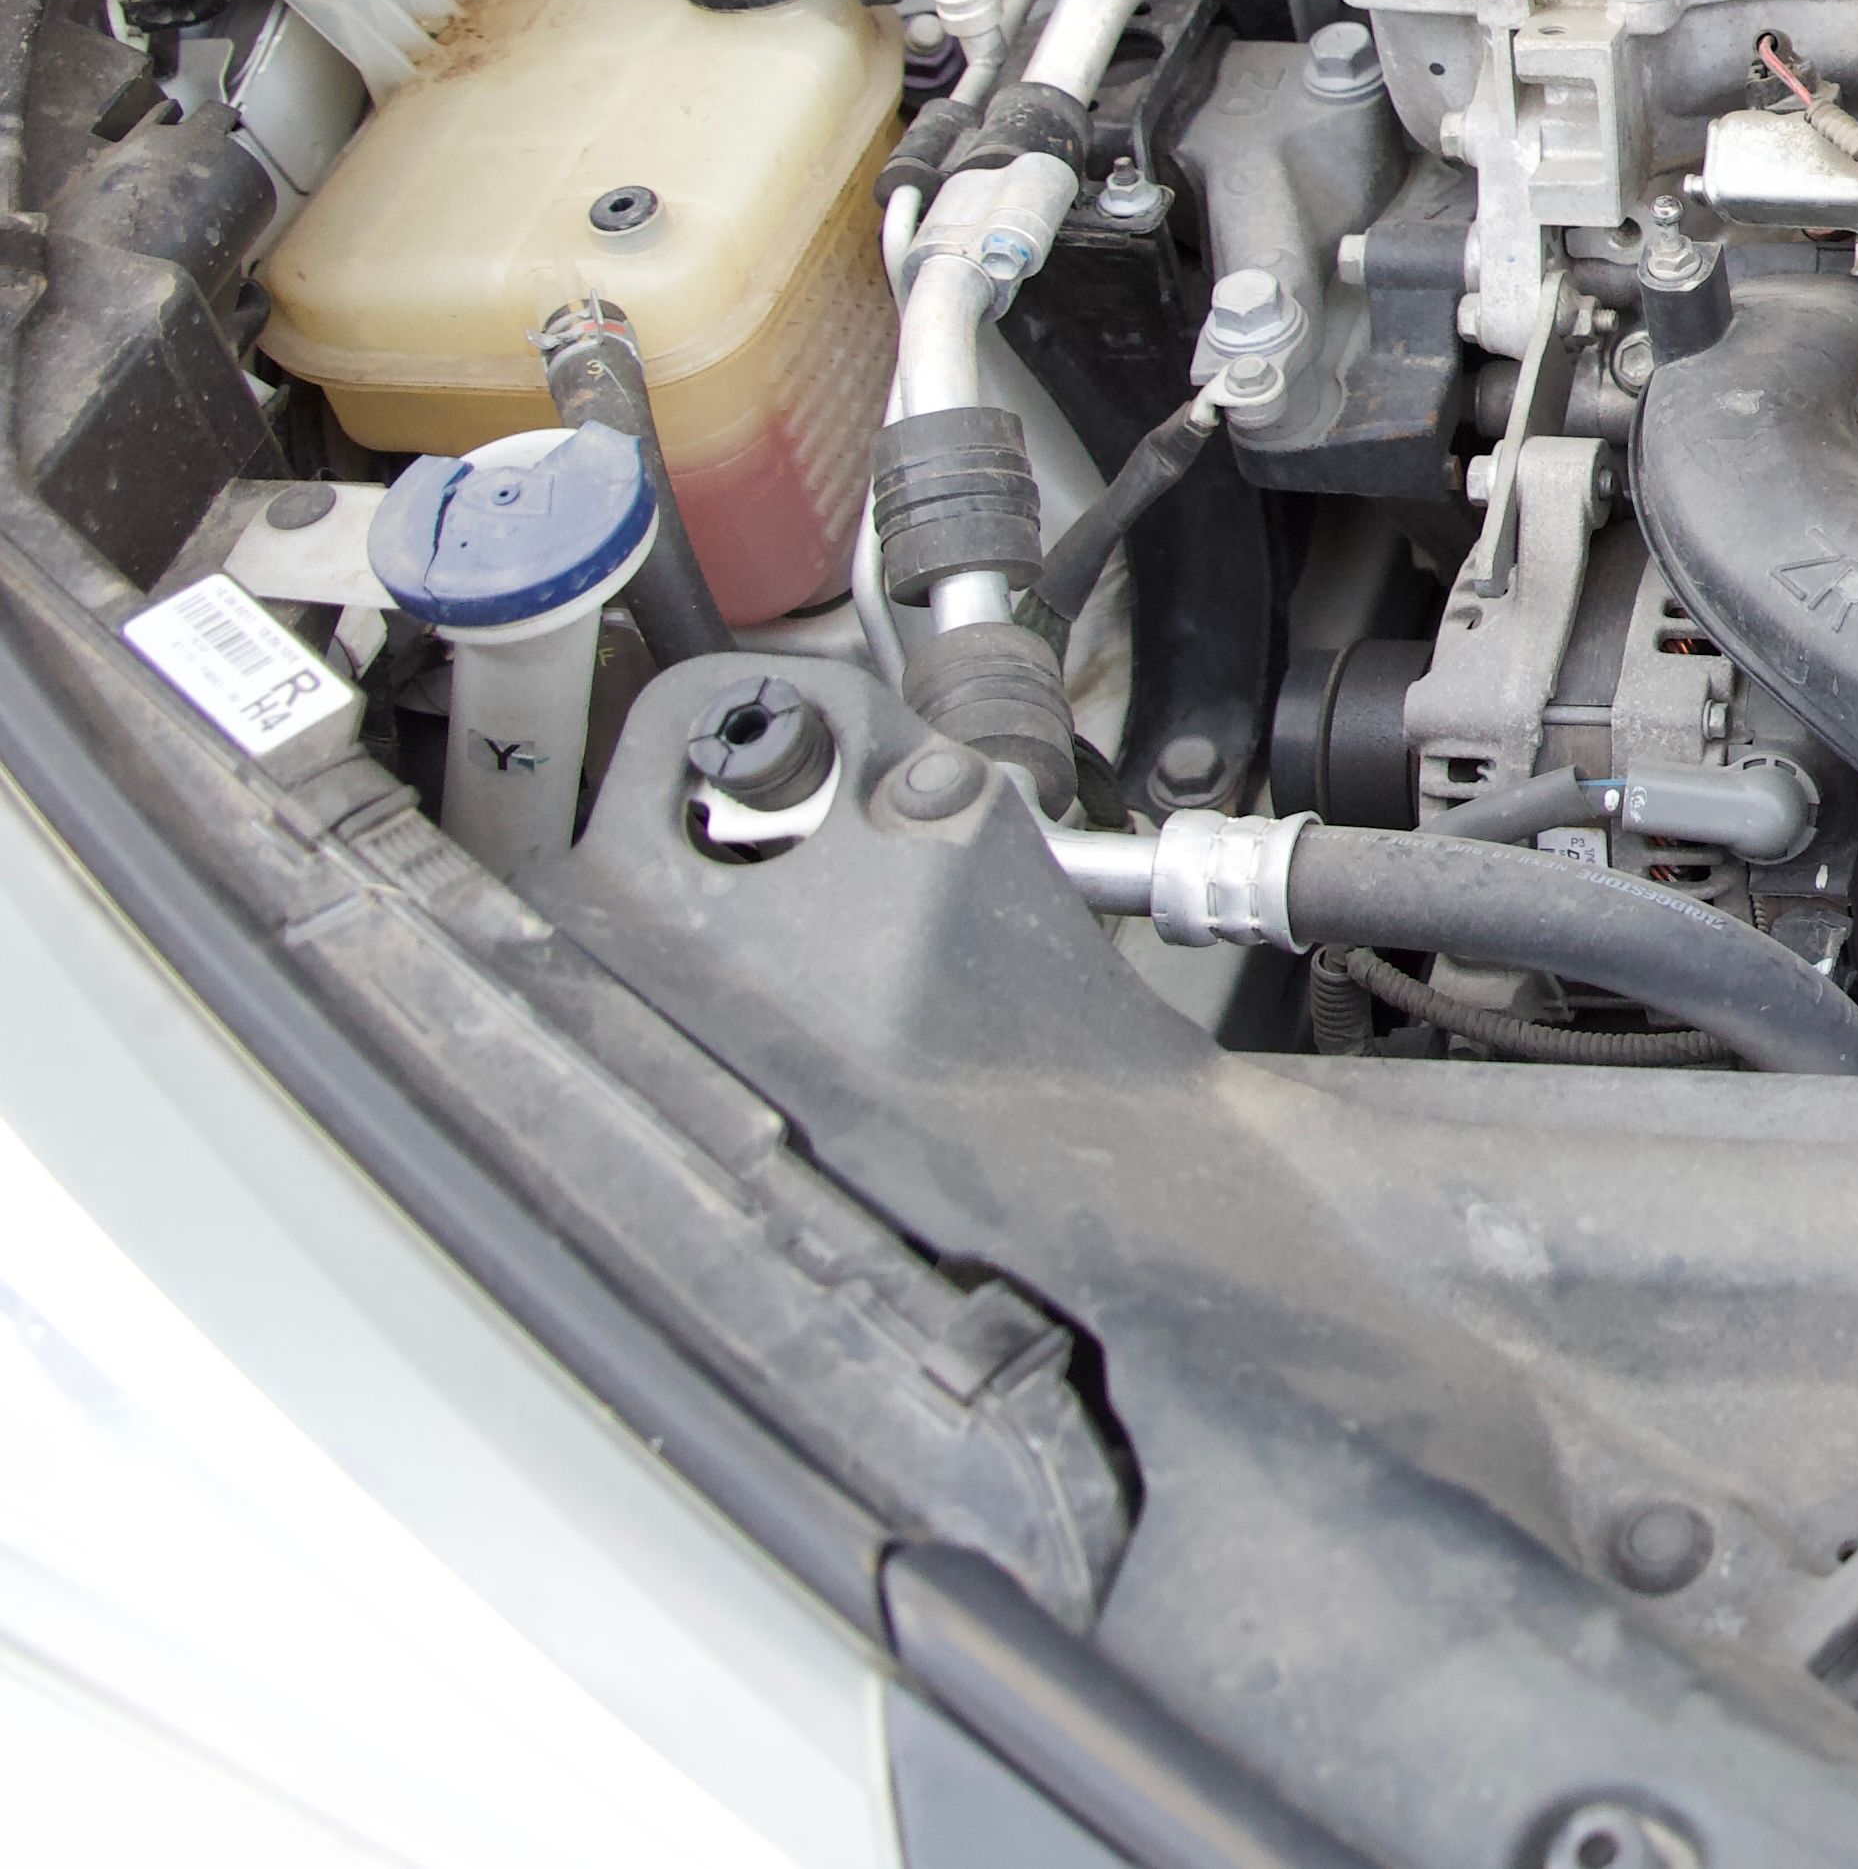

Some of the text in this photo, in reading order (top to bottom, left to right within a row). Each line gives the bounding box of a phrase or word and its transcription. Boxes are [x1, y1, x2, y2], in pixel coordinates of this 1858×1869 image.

[270, 668, 321, 707] R
[240, 693, 292, 732] H4
[484, 738, 521, 771] Y
[1570, 837, 1586, 848] P3
[1576, 870, 1727, 931] BRIDGESTONE
